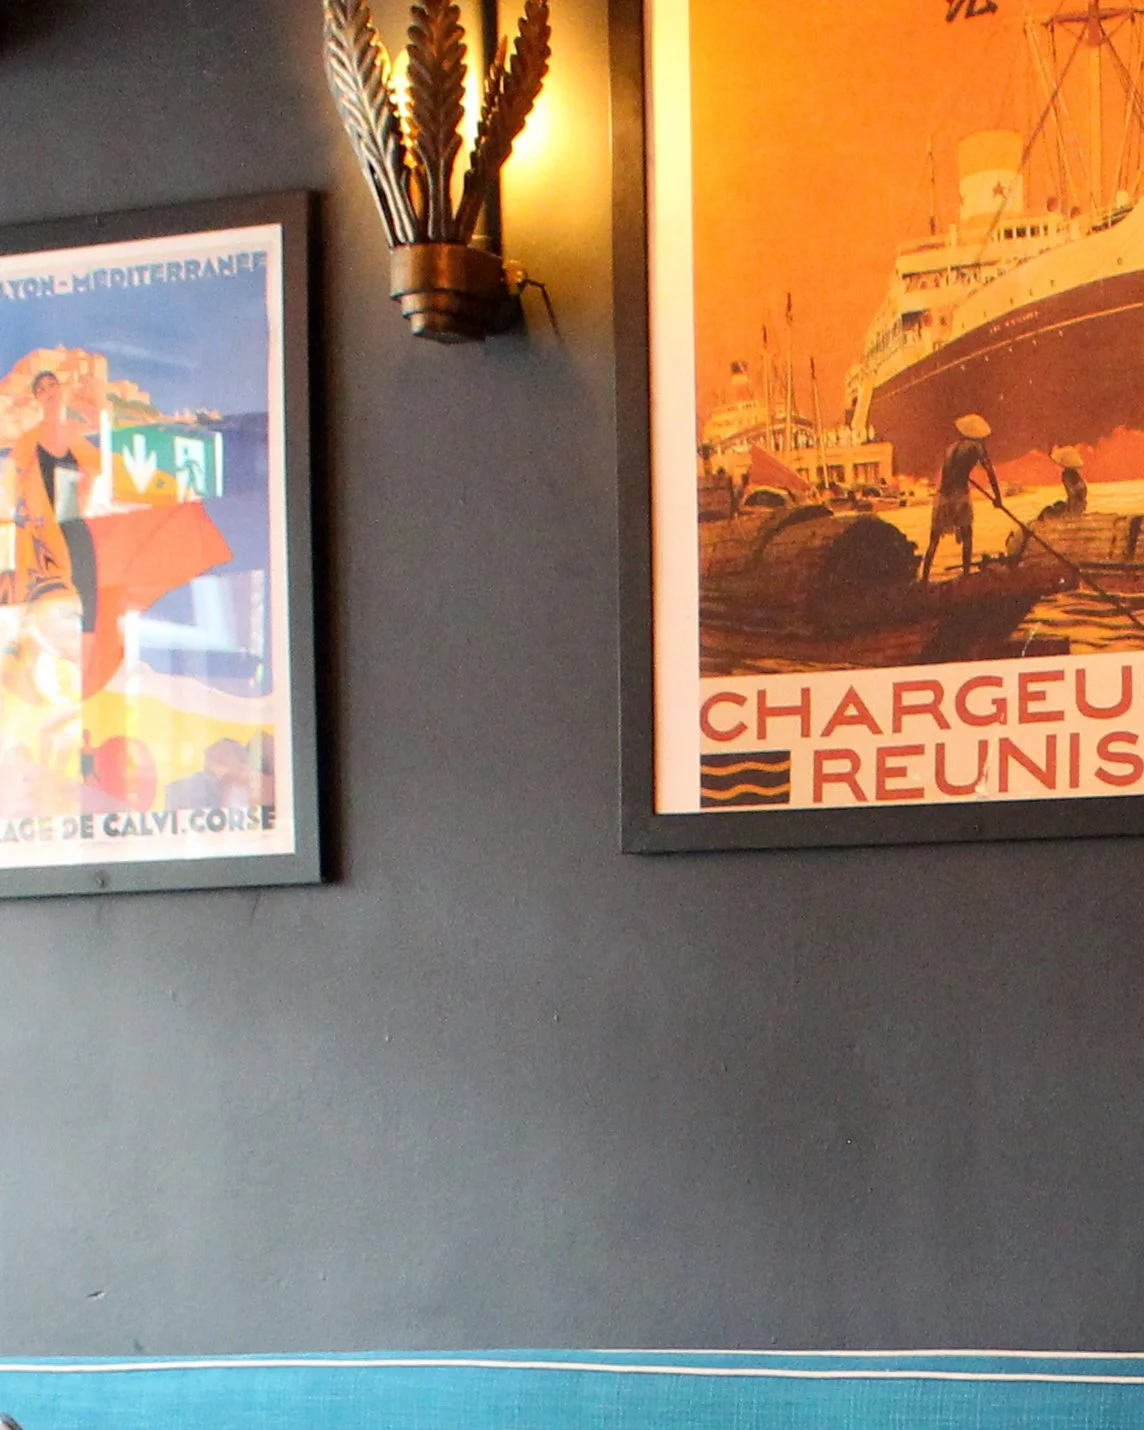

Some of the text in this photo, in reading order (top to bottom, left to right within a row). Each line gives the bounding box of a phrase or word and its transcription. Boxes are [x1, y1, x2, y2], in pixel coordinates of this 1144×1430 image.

[812, 730, 1144, 803] REUNIS
[0, 816, 54, 843] AGE
[62, 812, 94, 840] DE
